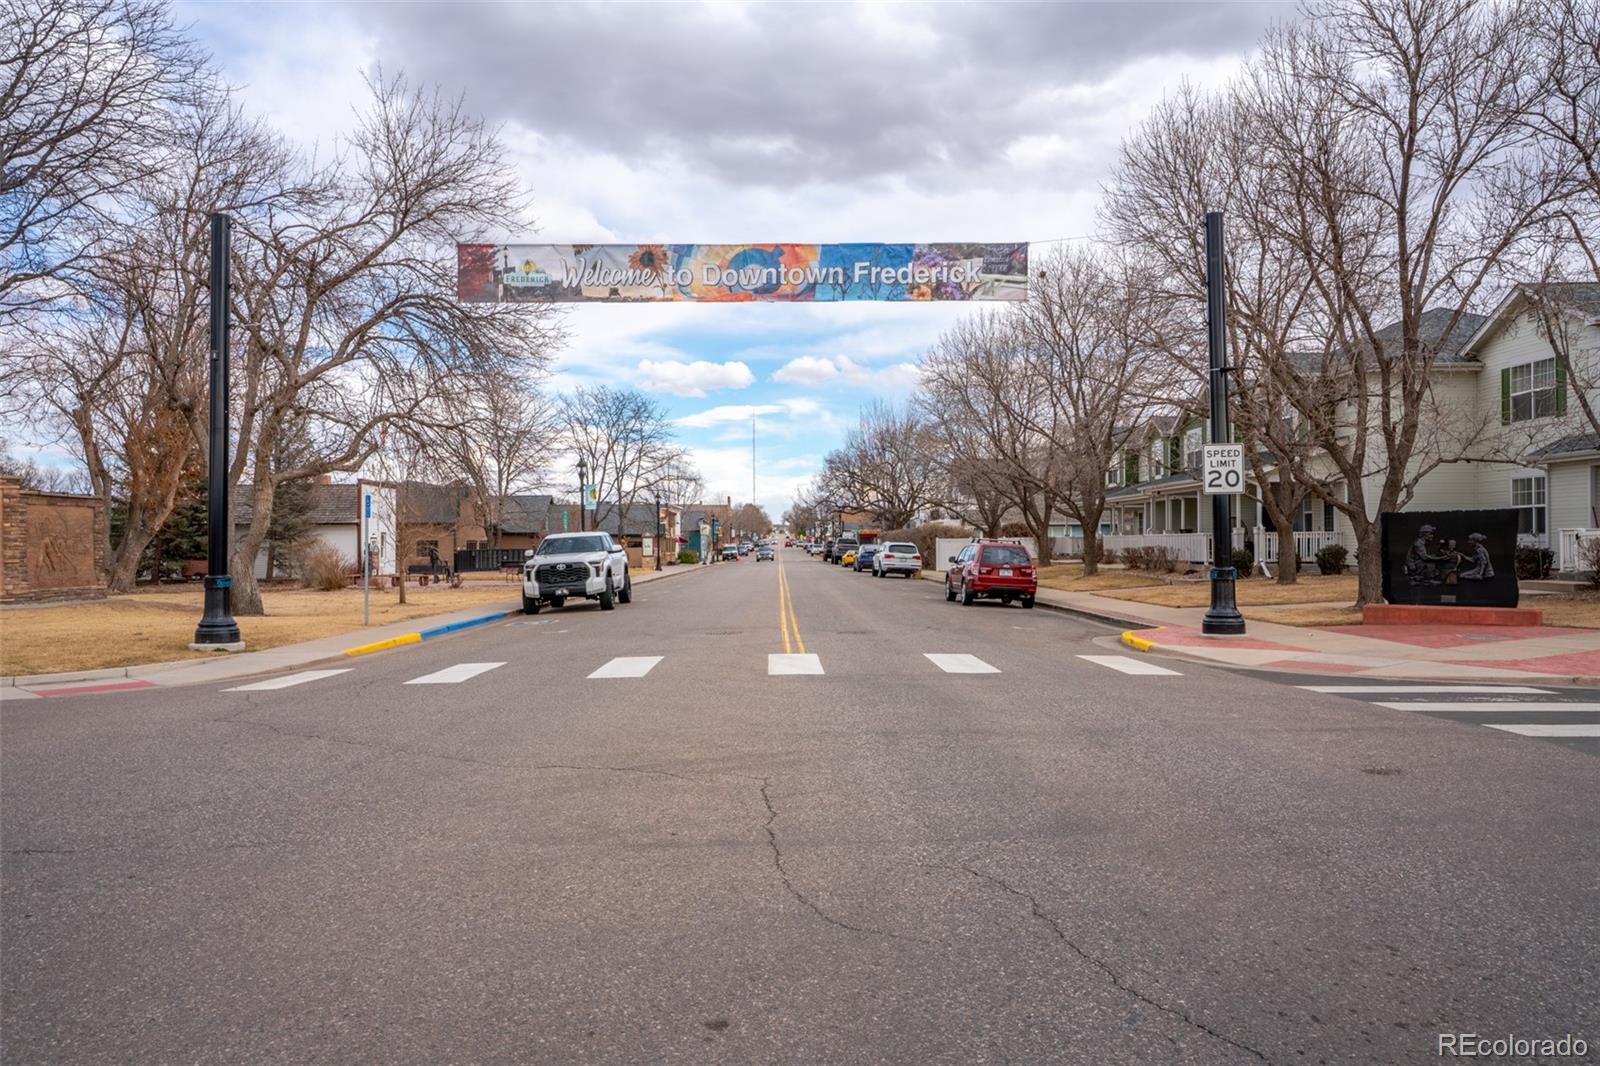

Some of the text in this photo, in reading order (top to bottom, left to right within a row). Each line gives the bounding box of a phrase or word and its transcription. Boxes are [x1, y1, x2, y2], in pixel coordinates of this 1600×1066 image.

[560, 257, 981, 288] Welcome to Downtown Frederick
[505, 275, 550, 283] FREDERICK
[1206, 449, 1241, 458] SPEED
[1210, 459, 1237, 468] LIMIT
[1208, 469, 1240, 488] 20
